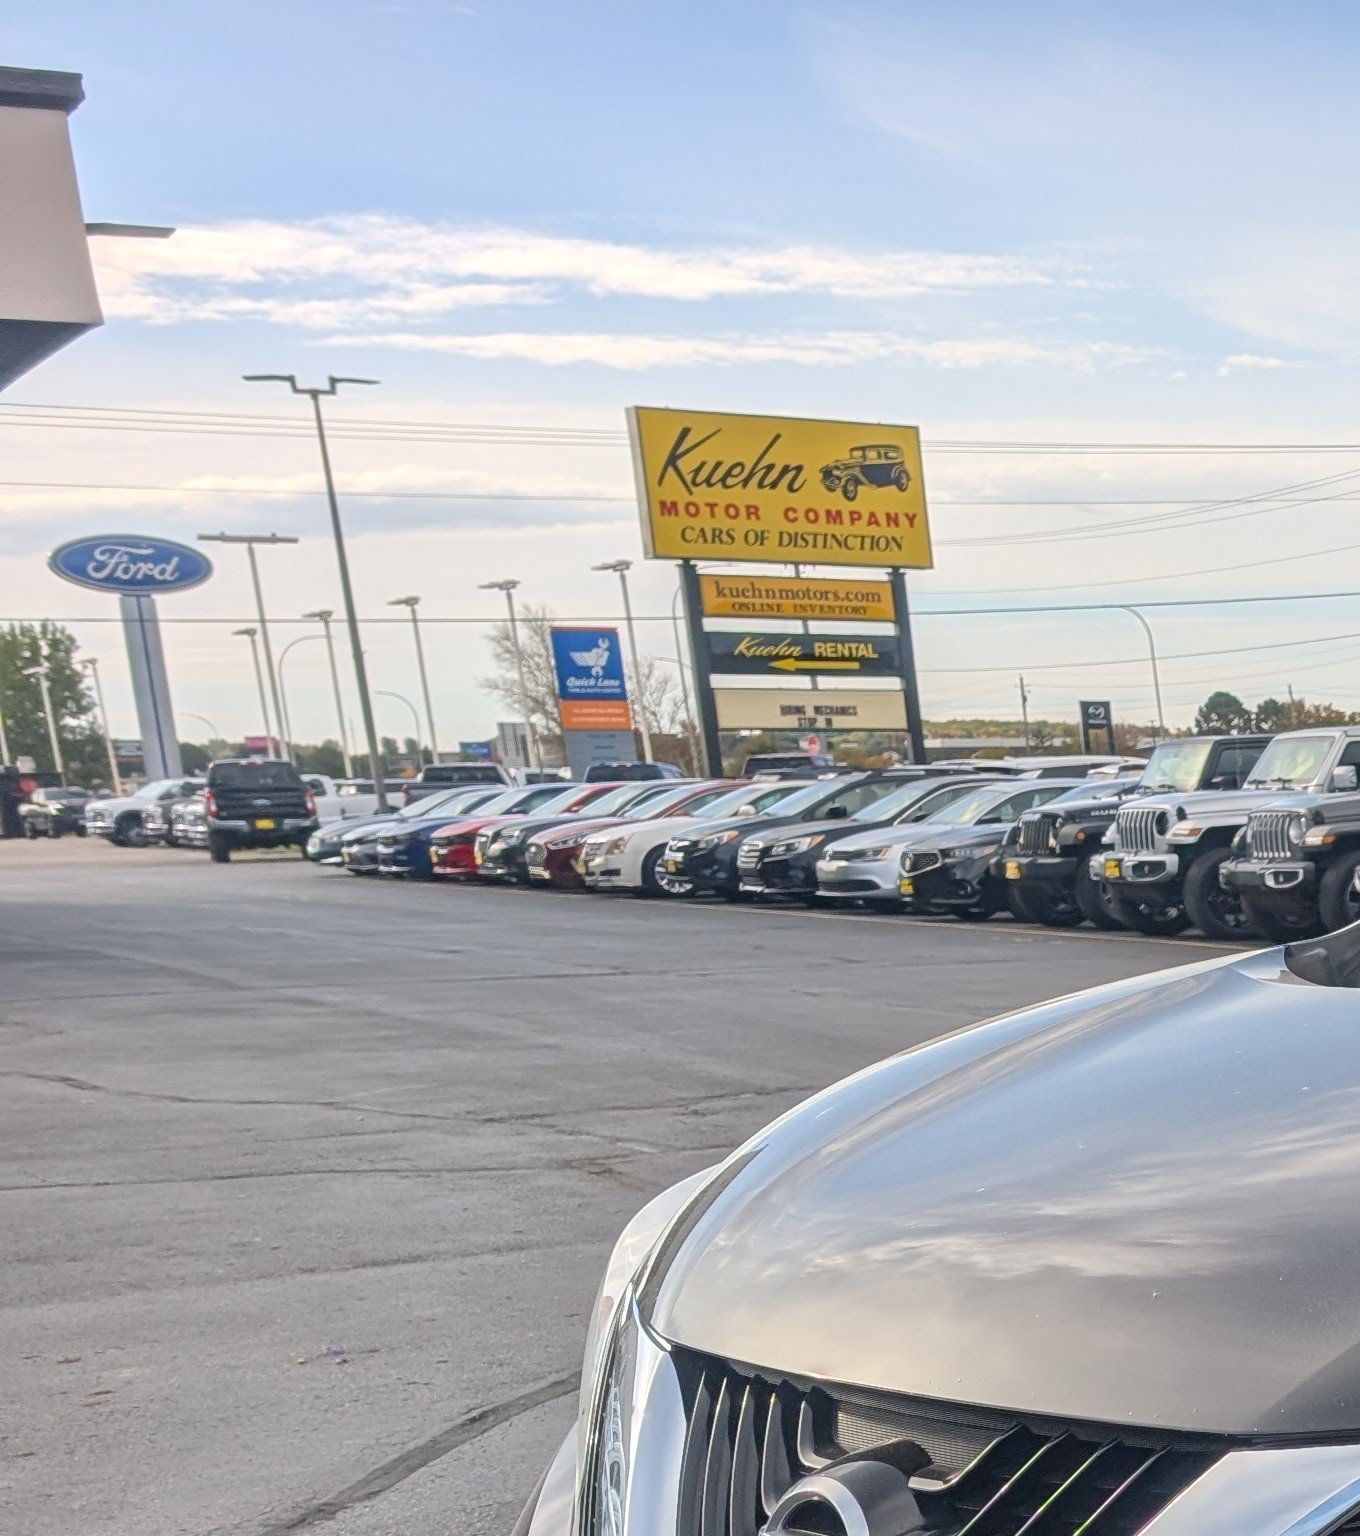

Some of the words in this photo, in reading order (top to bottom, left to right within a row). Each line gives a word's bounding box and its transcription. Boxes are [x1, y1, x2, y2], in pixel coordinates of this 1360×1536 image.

[658, 427, 807, 496] Kuehn
[659, 500, 762, 521] MOTOR
[783, 506, 919, 529] COMPANY
[680, 525, 736, 547] CARS
[744, 528, 770, 548] OF
[777, 530, 904, 553] DISTINCTION
[87, 544, 181, 581] Ford
[713, 579, 882, 603] kuehnmotors.com
[731, 601, 784, 613] ONLINE
[793, 603, 868, 616] INVENTORY
[733, 635, 803, 659] Kuehn
[813, 642, 879, 659] RENTAL
